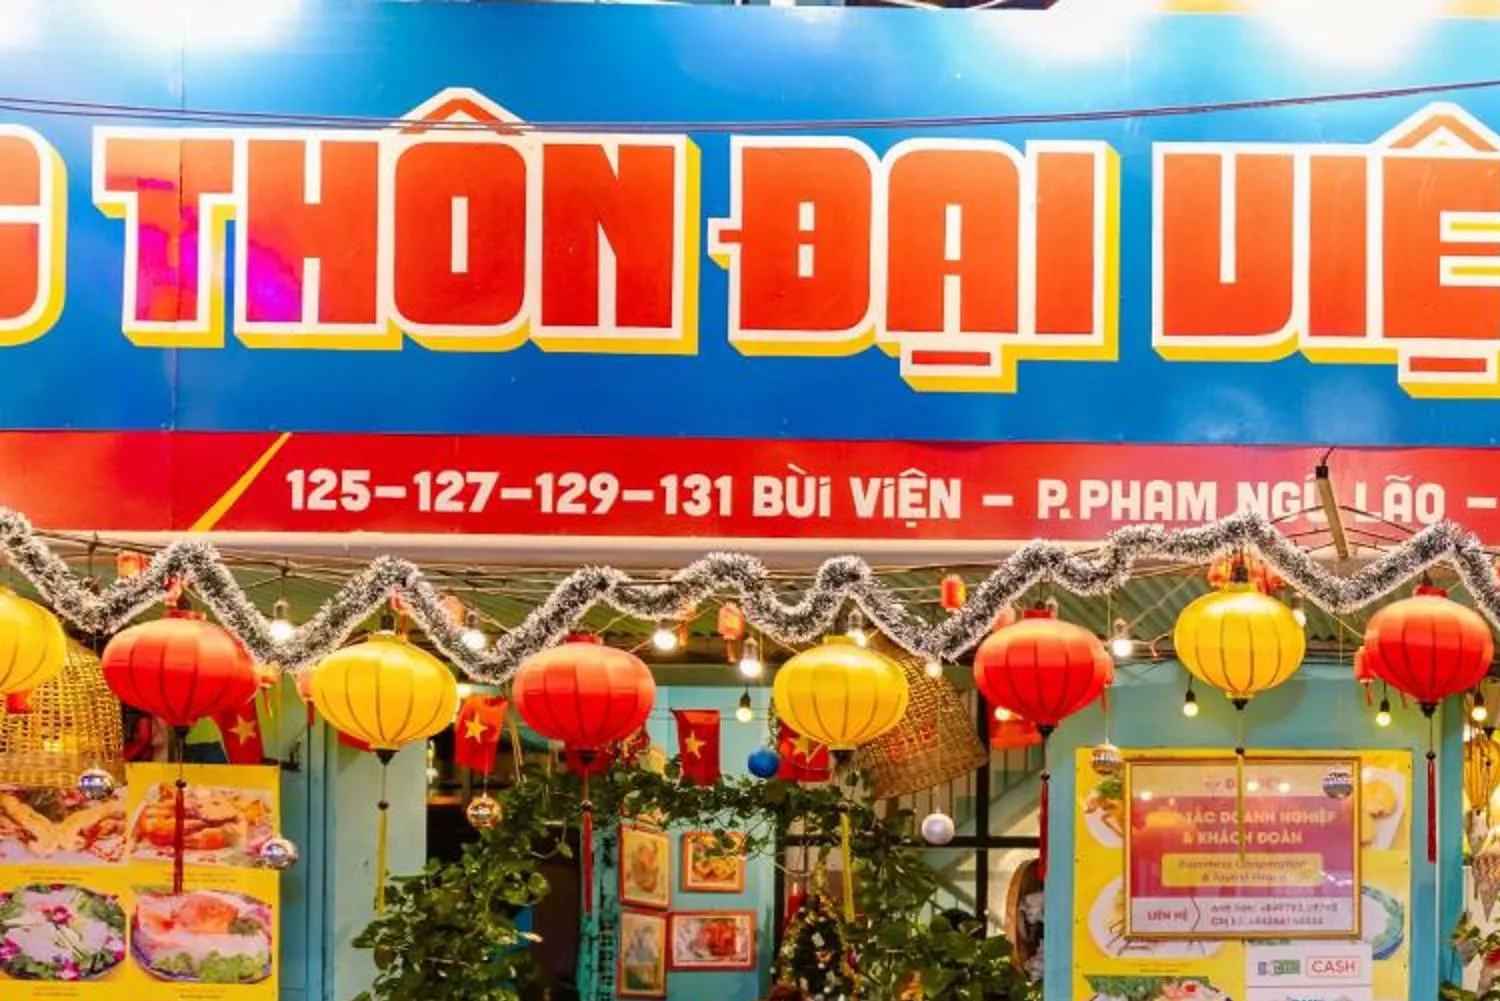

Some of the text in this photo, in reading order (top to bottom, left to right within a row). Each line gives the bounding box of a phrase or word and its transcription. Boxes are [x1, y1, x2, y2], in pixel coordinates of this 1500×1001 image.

[93, 87, 699, 354] THÔN
[708, 138, 1119, 392] ĐẠI
[1355, 475, 1445, 524] LÃO
[1311, 960, 1355, 974] CASH
